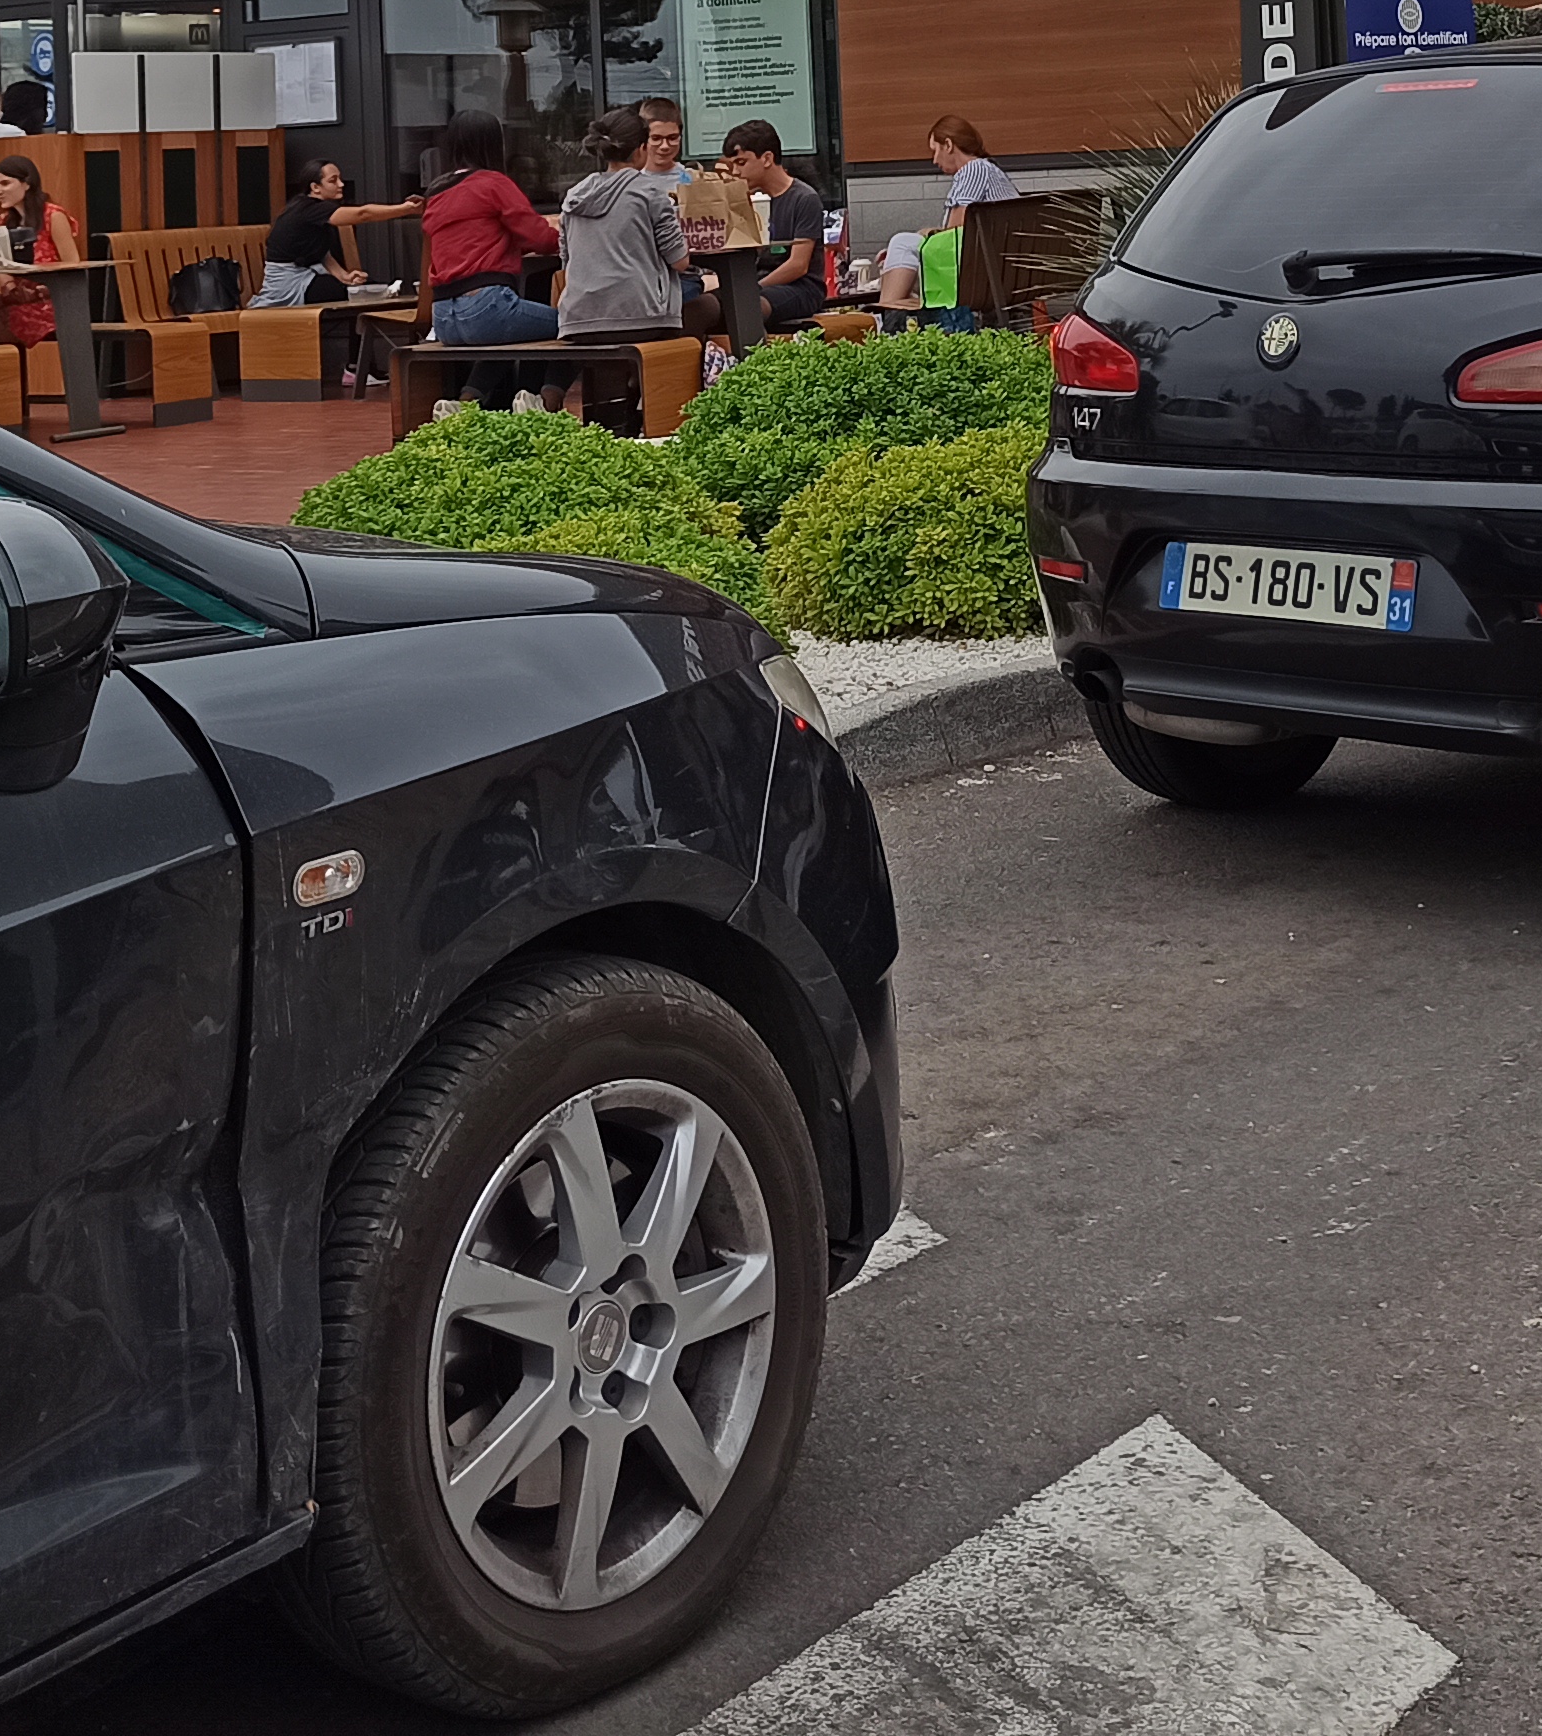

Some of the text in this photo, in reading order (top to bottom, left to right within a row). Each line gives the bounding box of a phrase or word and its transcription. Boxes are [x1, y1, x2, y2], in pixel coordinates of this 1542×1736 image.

[1355, 31, 1397, 49] Prépare
[1399, 32, 1416, 45] ton
[1072, 407, 1101, 430] 147
[1166, 581, 1175, 594] F
[1389, 597, 1410, 622] 31
[301, 908, 353, 938] TDI
